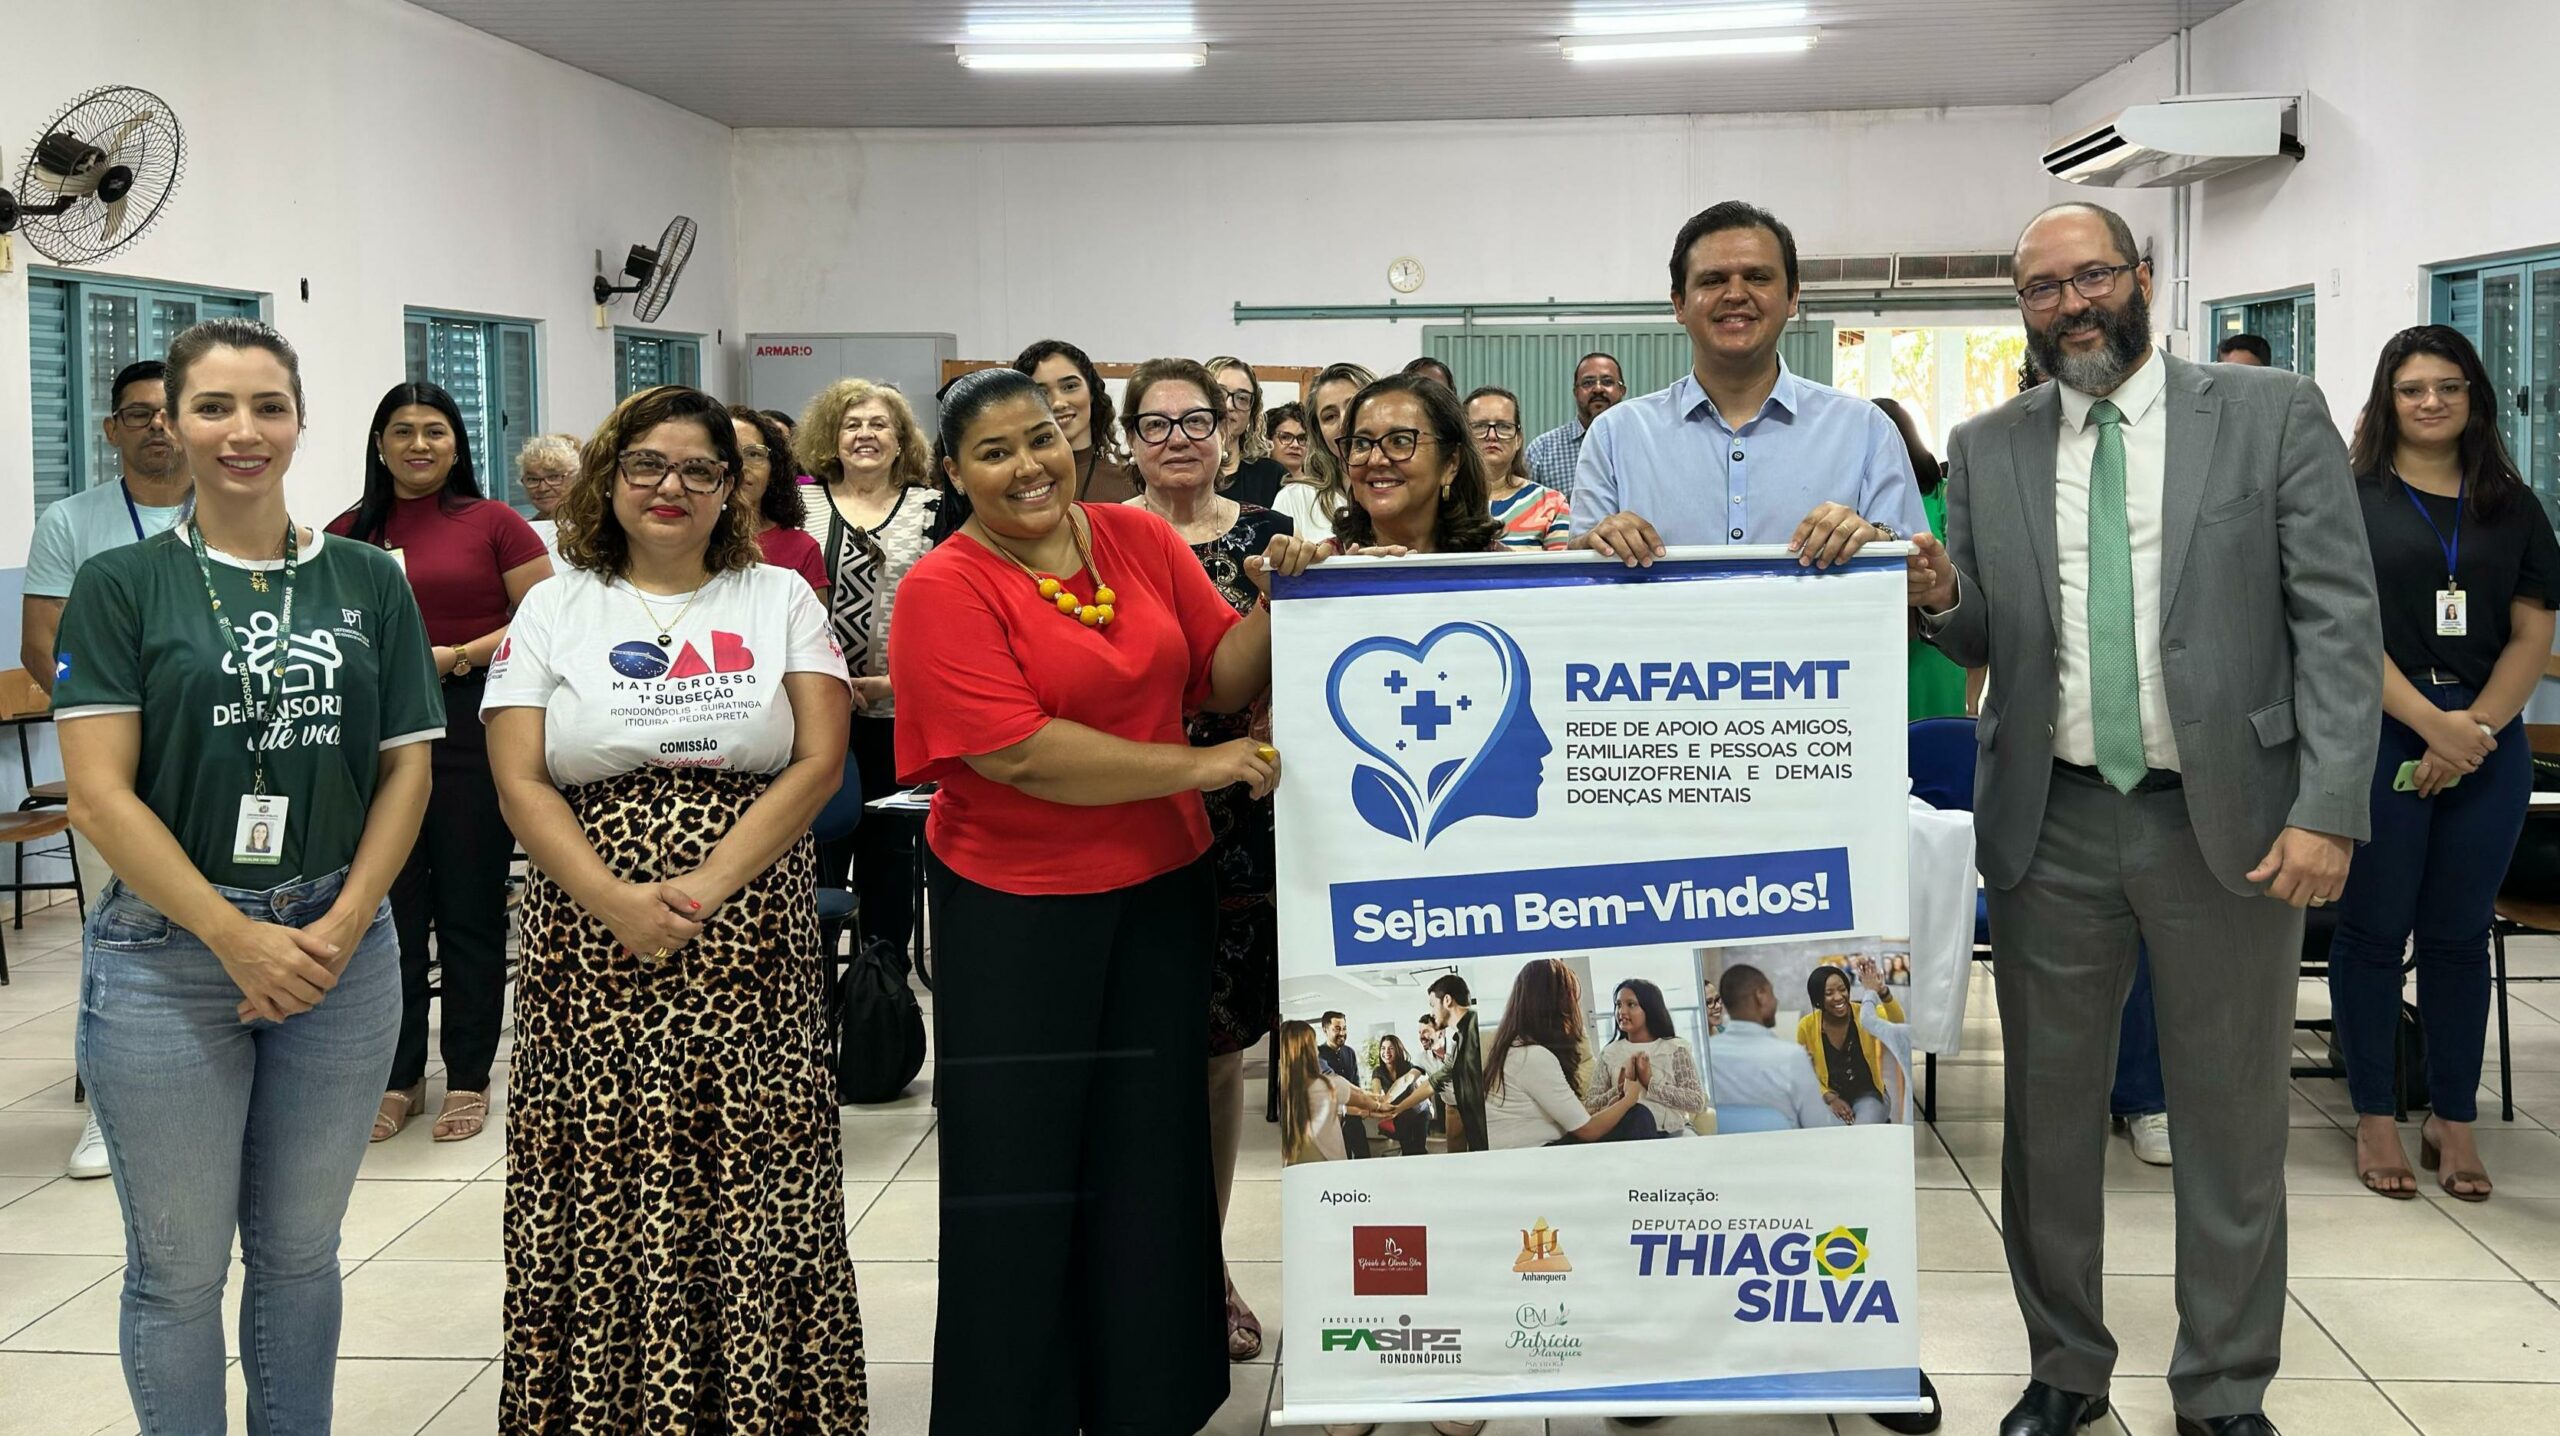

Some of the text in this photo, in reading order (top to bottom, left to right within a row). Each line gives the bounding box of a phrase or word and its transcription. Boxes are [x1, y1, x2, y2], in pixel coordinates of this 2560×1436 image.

[612, 674, 756, 691] MATO GROSSO
[1566, 660, 1850, 702] RAFAPEMT
[237, 662, 255, 719] DEFENSORAR
[655, 687, 734, 705] SUBSEÇÃO
[610, 706, 691, 716] RONDONÓPOLIS
[701, 700, 762, 712] GUIRATINGA
[625, 717, 669, 727] ITIQUIRA
[679, 713, 713, 723] PEDRA
[716, 711, 749, 721] PRETA
[1566, 719, 1852, 737] REDE DE APOIO AOS AMIGOS,
[660, 738, 718, 754] COMISSÃO
[1566, 742, 1852, 759] FAMILIARES E PESSOAS COM
[1567, 764, 1853, 782] ESQUIZOFRENIA E DEMAIS
[1567, 787, 1751, 806] DOENÇAS MENTAIS
[1353, 872, 1831, 947] Sejam Bem-Vindos!
[1320, 1189, 1371, 1206] Apoio:
[1628, 1189, 1719, 1205] Realização:
[1632, 1218, 1814, 1231] DEPUTADO ESTADUAL
[1521, 1273, 1567, 1284] Anhanguera
[1734, 1279, 1899, 1323] SILVA
[1505, 1330, 1583, 1349] Patrícia
[1380, 1352, 1462, 1364] RONDONÓPOLIS
